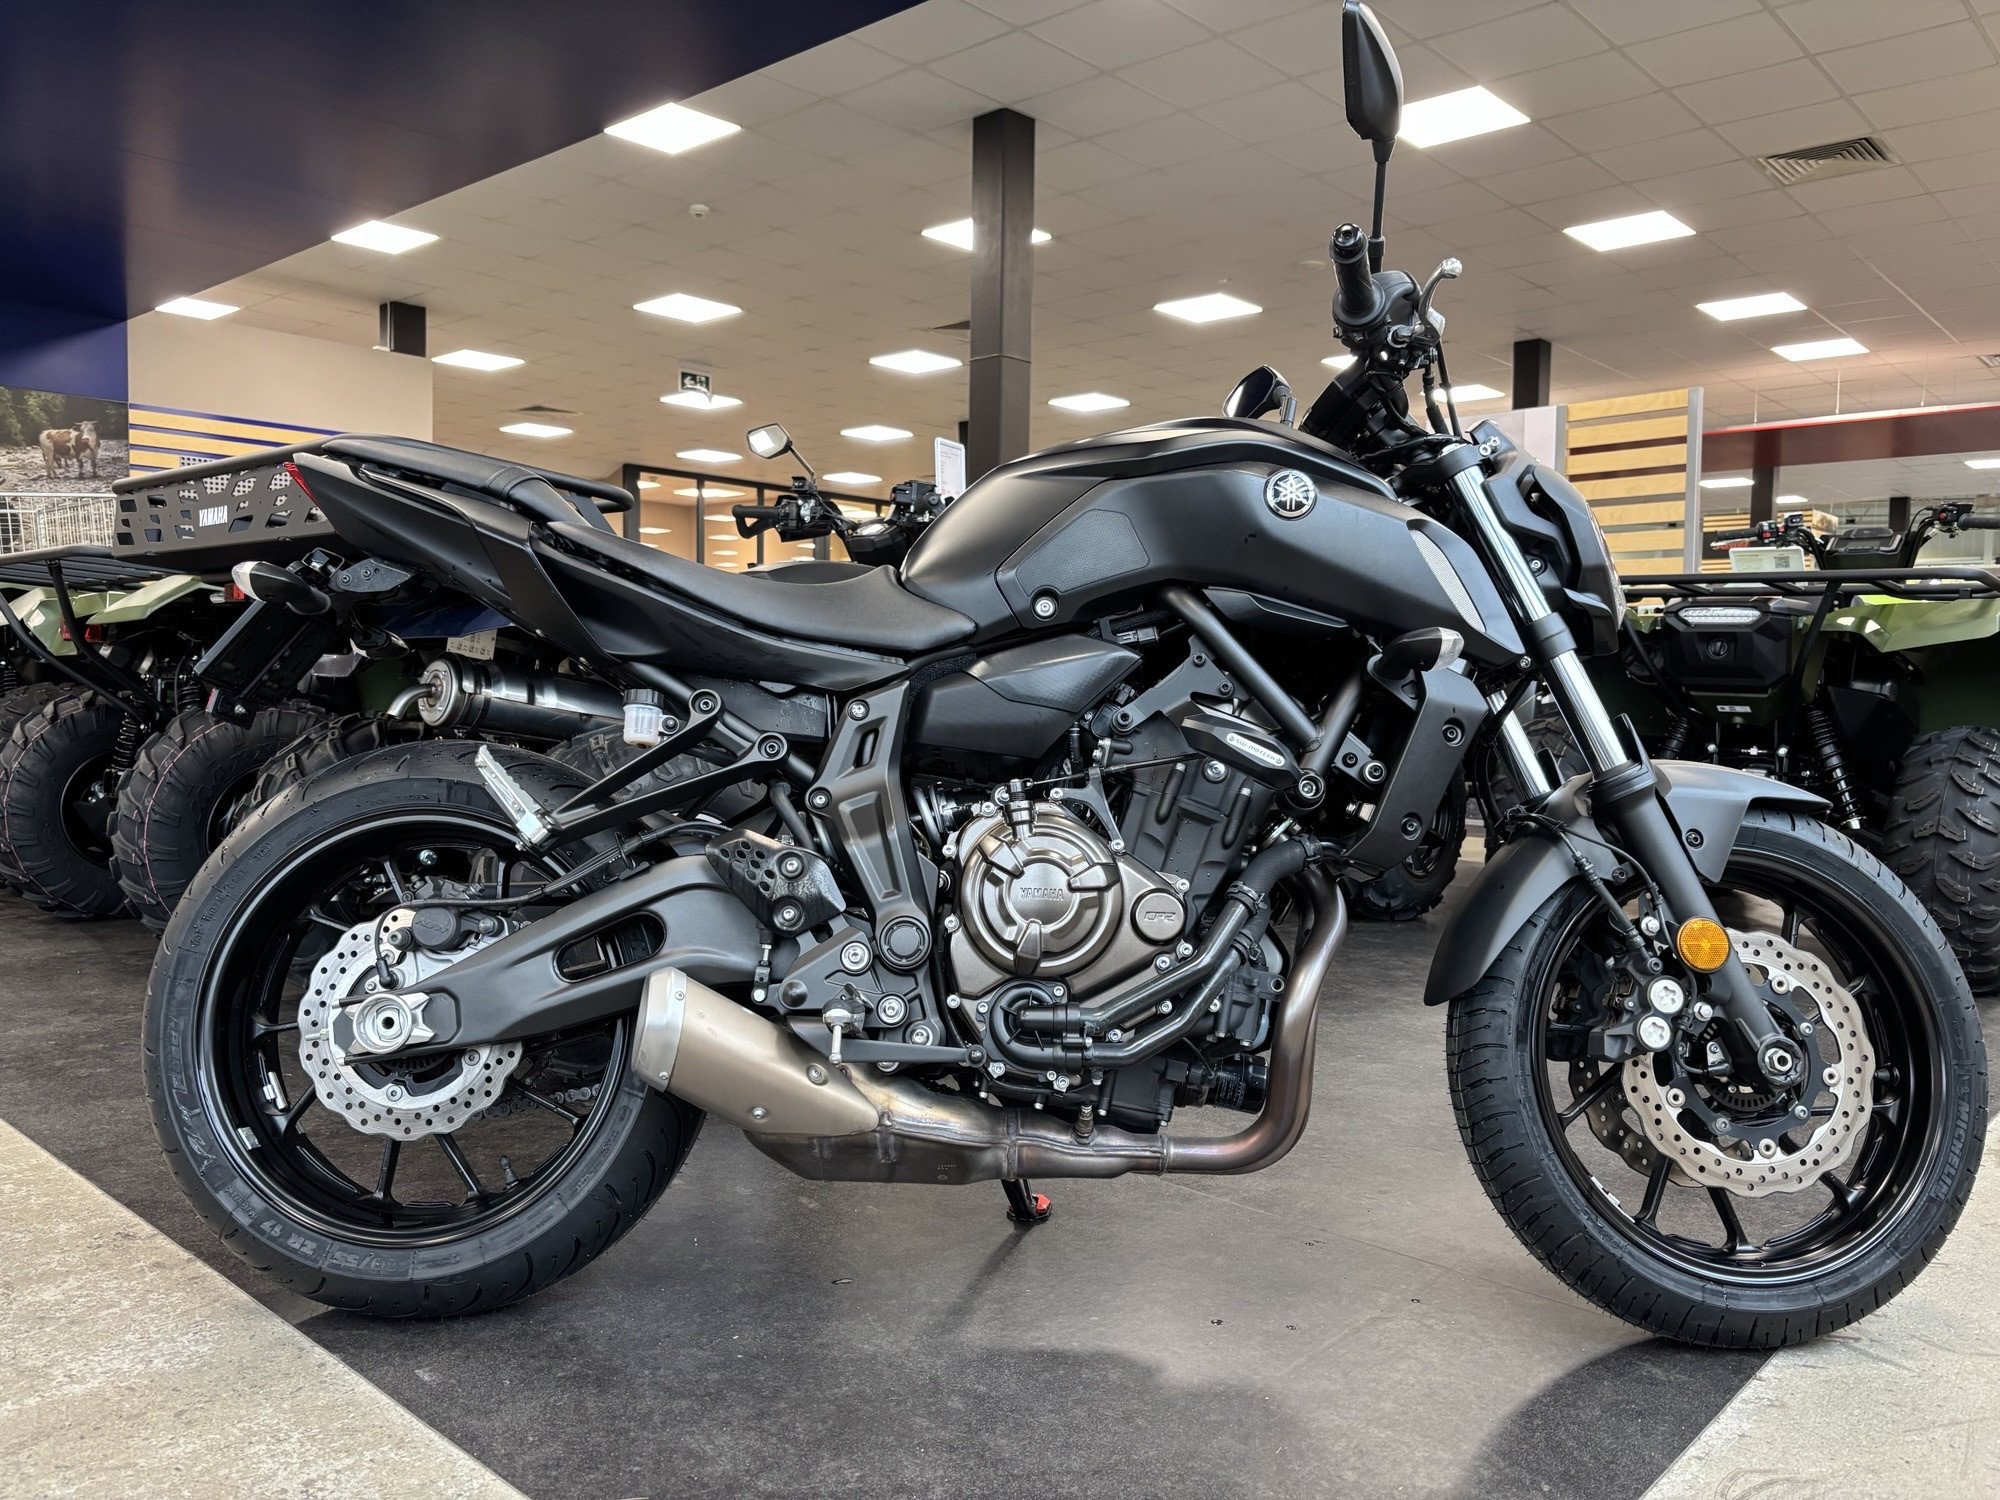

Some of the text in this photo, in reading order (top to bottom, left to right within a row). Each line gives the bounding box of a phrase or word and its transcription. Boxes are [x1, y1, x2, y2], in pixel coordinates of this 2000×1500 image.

[199, 505, 228, 527] YAMAHA
[1236, 738, 1276, 761] SW-MOTECH
[1020, 887, 1065, 900] YAMAHA
[1928, 1100, 1970, 1201] MICHELIN
[260, 1220, 283, 1237] 17
[287, 1232, 318, 1255] ZR
